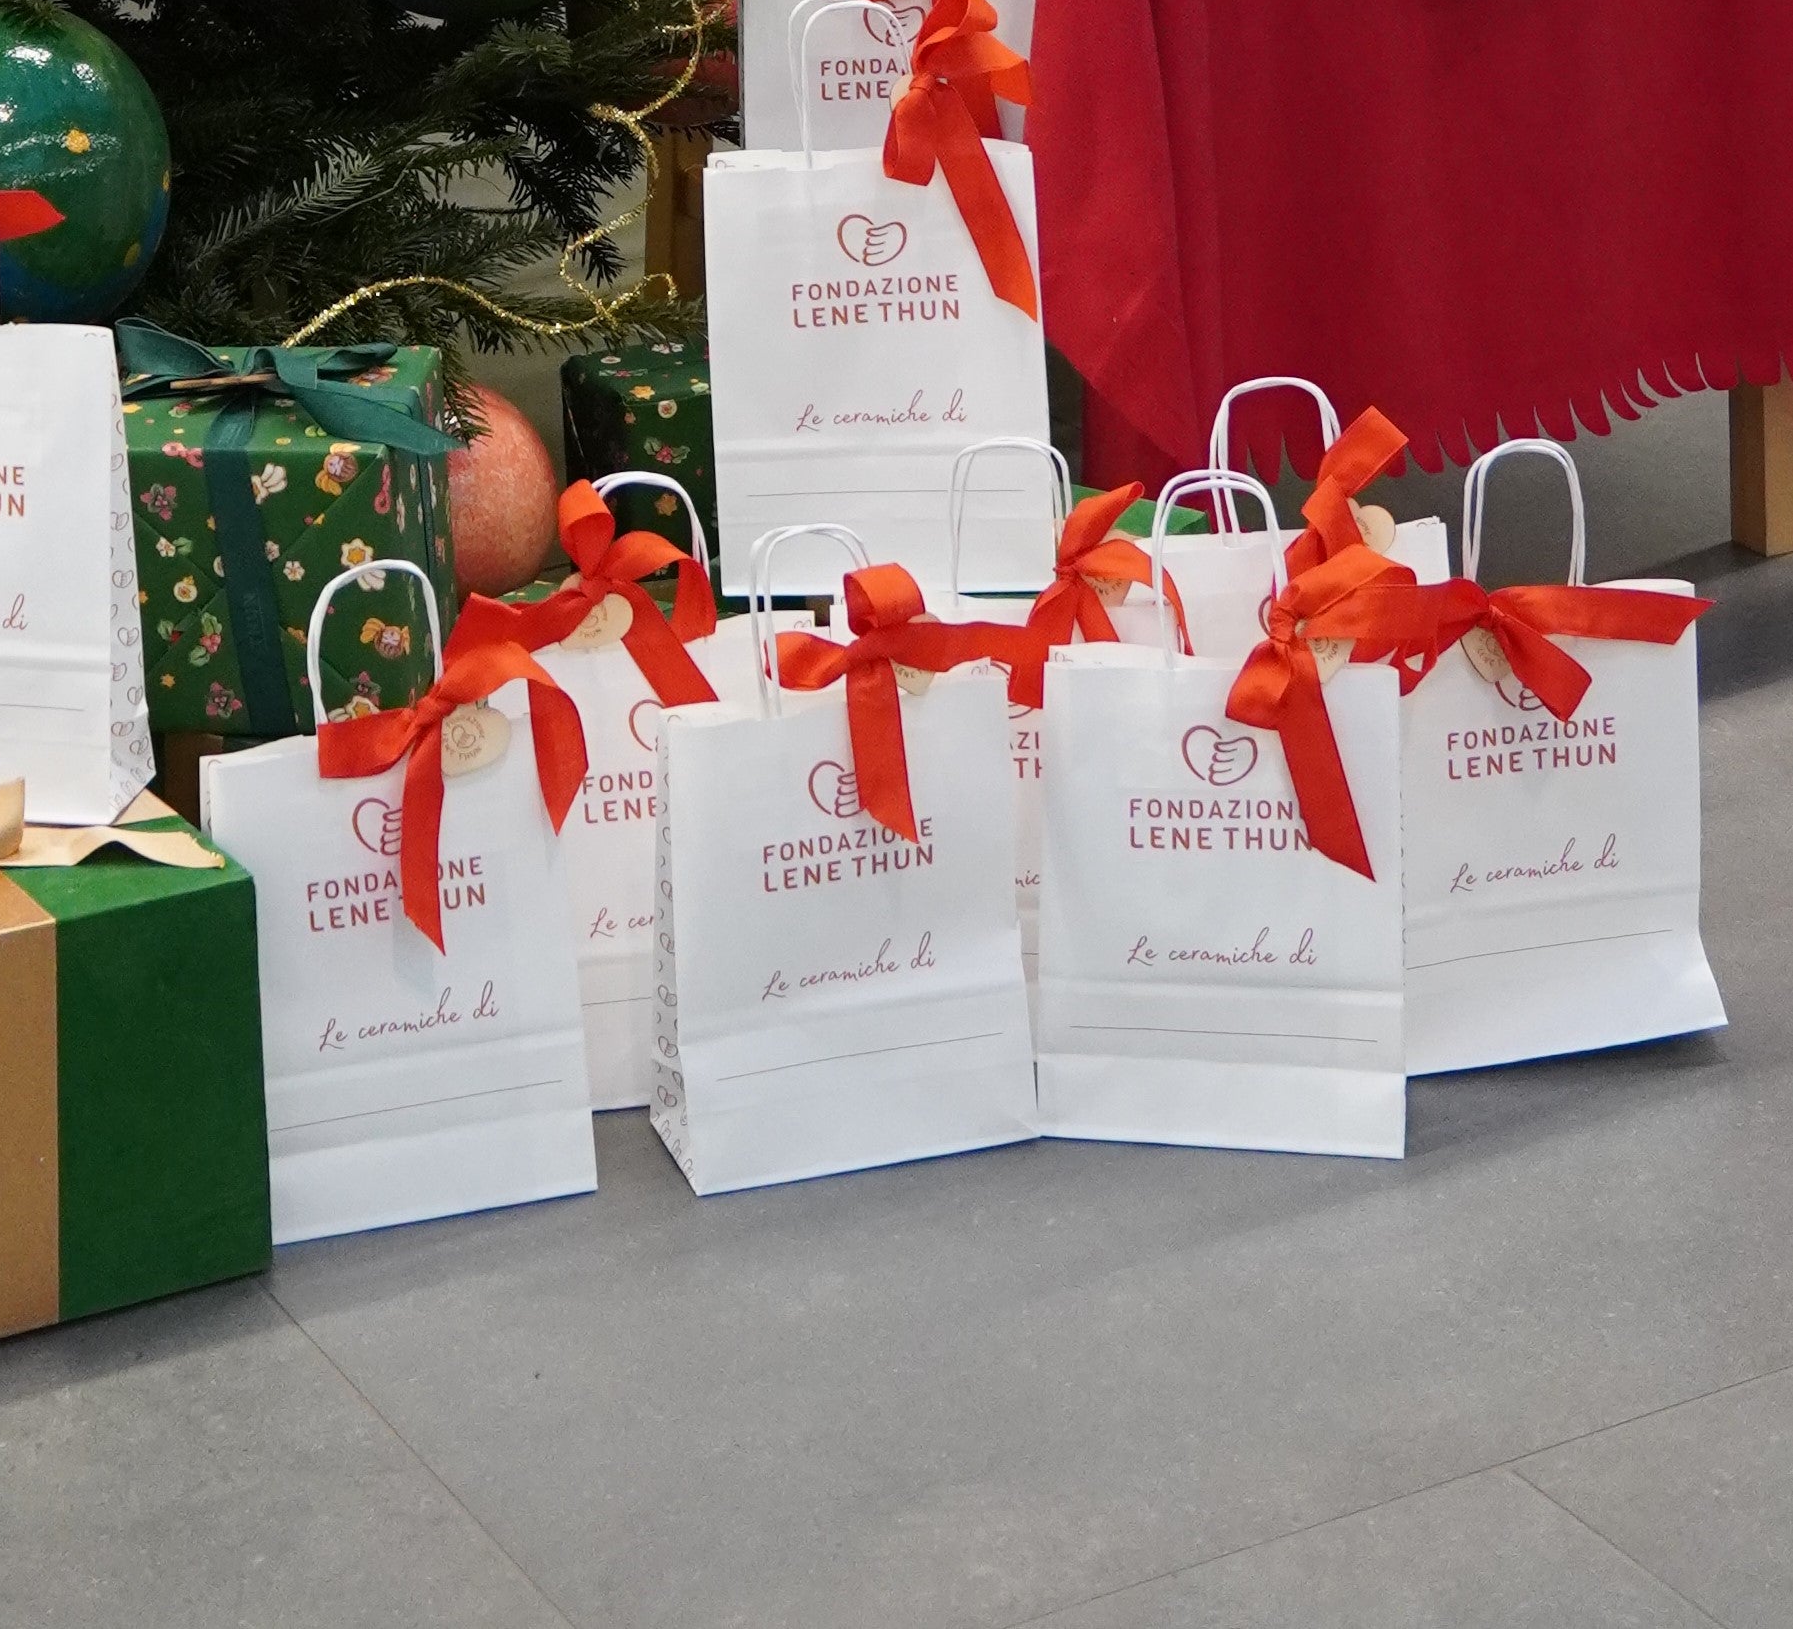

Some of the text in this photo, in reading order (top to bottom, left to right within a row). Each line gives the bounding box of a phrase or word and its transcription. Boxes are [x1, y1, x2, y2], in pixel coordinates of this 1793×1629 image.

[821, 80, 889, 101] LENE
[792, 274, 959, 302] FONDAZIONE
[793, 299, 960, 329] LENE THUN
[796, 388, 967, 432] Le ceramiche di
[2, 593, 28, 631] di
[1447, 716, 1616, 751] FONDAZIONE
[1448, 742, 1616, 781] LENE THUN
[1130, 826, 1213, 851] LENE
[764, 844, 934, 893] LENE THUN
[1450, 833, 1620, 893] Le ceramiche di
[309, 897, 390, 933] LENE
[590, 907, 618, 939] Le
[1127, 926, 1317, 967] Le ceramiche di
[762, 931, 936, 1001] Le ceramiche di
[319, 980, 500, 1052] Le ceramiche di
